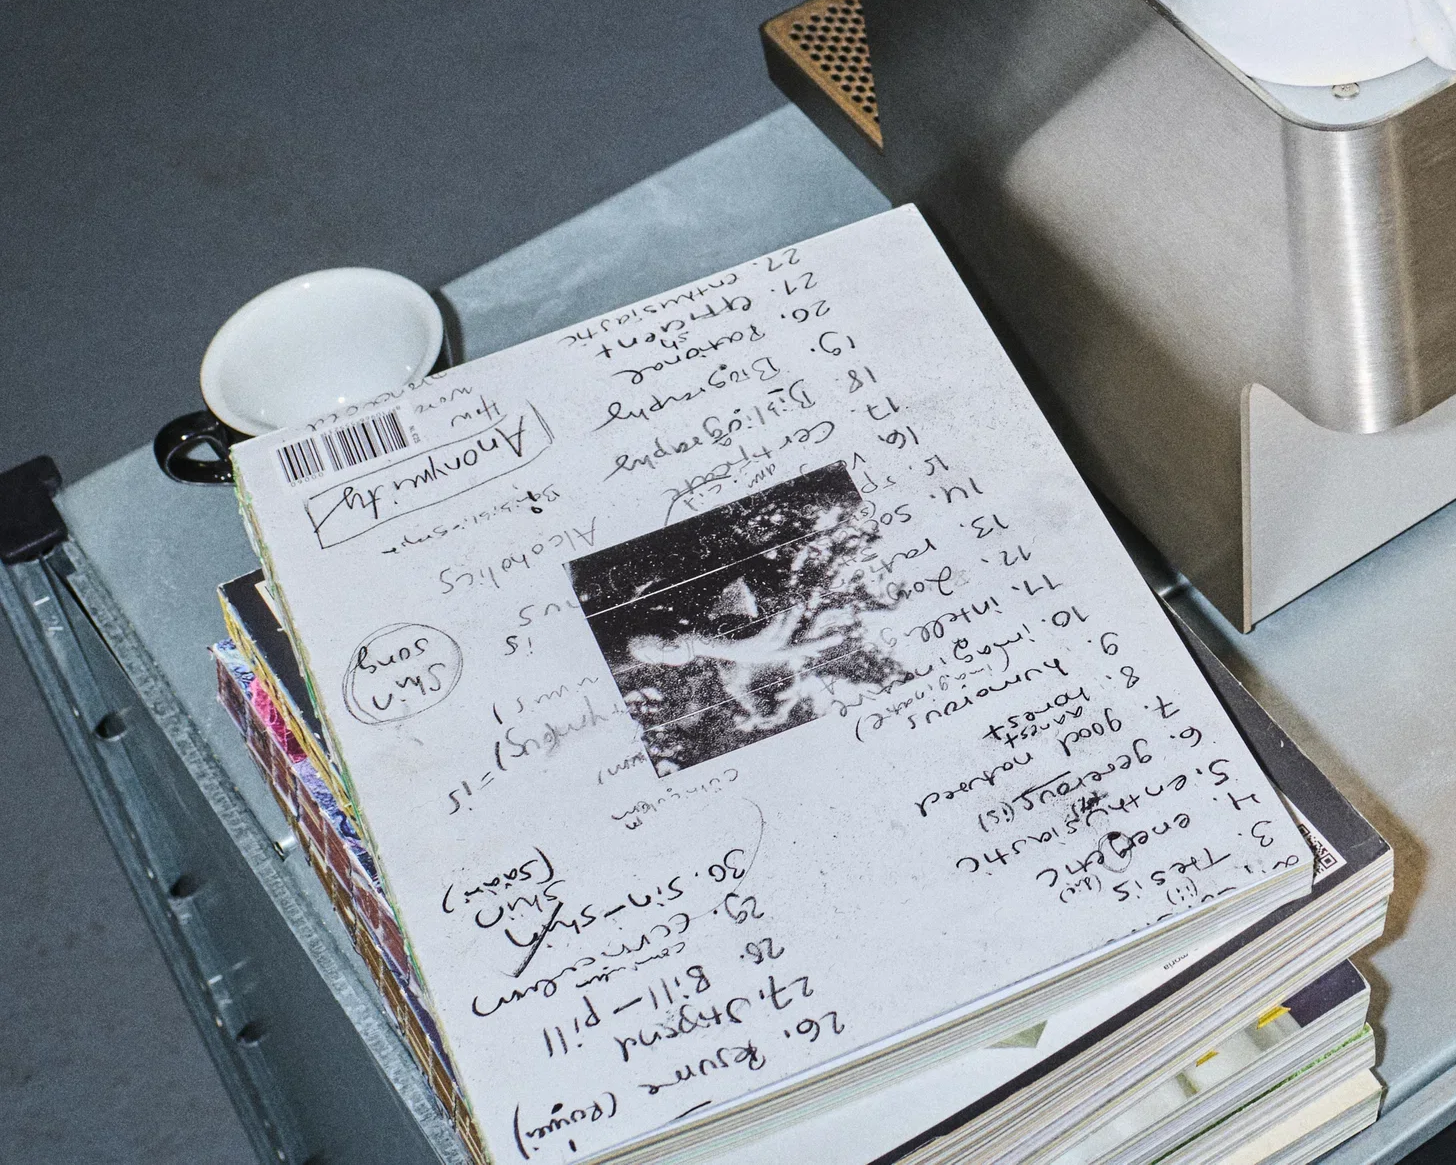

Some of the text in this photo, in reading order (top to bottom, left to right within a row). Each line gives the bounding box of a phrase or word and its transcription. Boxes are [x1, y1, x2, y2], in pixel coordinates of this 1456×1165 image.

[314, 415, 525, 533] Anonymity
[438, 516, 596, 595] Alcoholics
[907, 659, 1068, 729] humorous
[1058, 708, 1121, 756] good
[913, 753, 1034, 816] natured
[759, 975, 814, 1010] 27.
[785, 1011, 845, 1043] 26.
